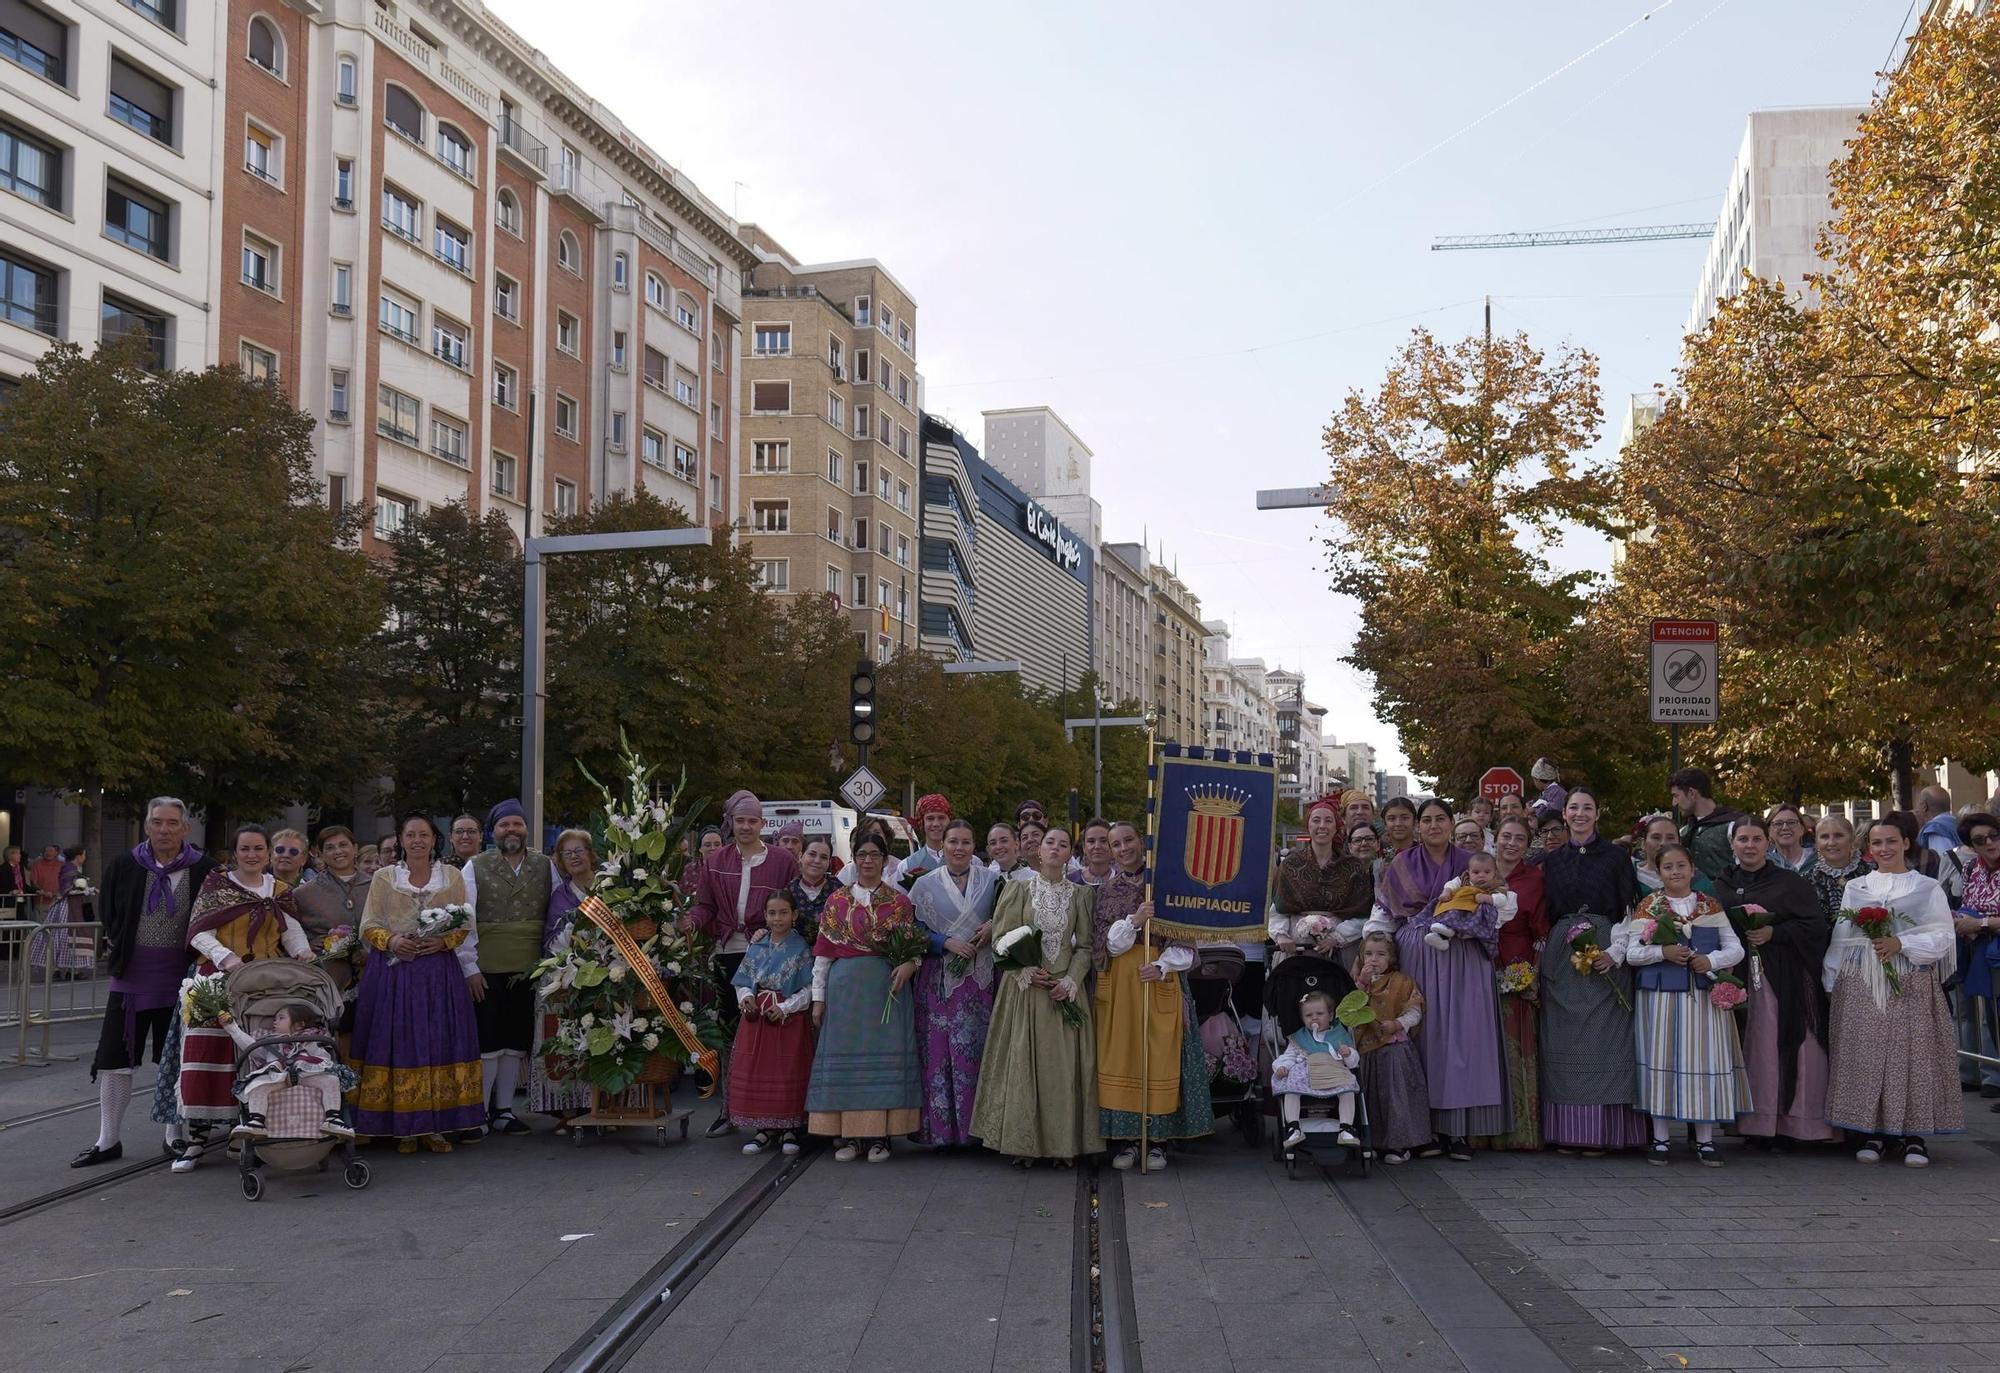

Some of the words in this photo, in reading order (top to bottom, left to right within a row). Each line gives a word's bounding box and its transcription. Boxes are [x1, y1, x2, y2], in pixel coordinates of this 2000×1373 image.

[1027, 501, 1036, 534] El
[1037, 511, 1056, 548] Corte
[1668, 661, 1701, 681] 20
[1658, 696, 1711, 705] PRIORIDAD
[1660, 708, 1710, 717] PEATONAL
[853, 781, 873, 797] 30
[1484, 783, 1519, 794] STOP
[1165, 894, 1251, 913] LUMPIAQUE
